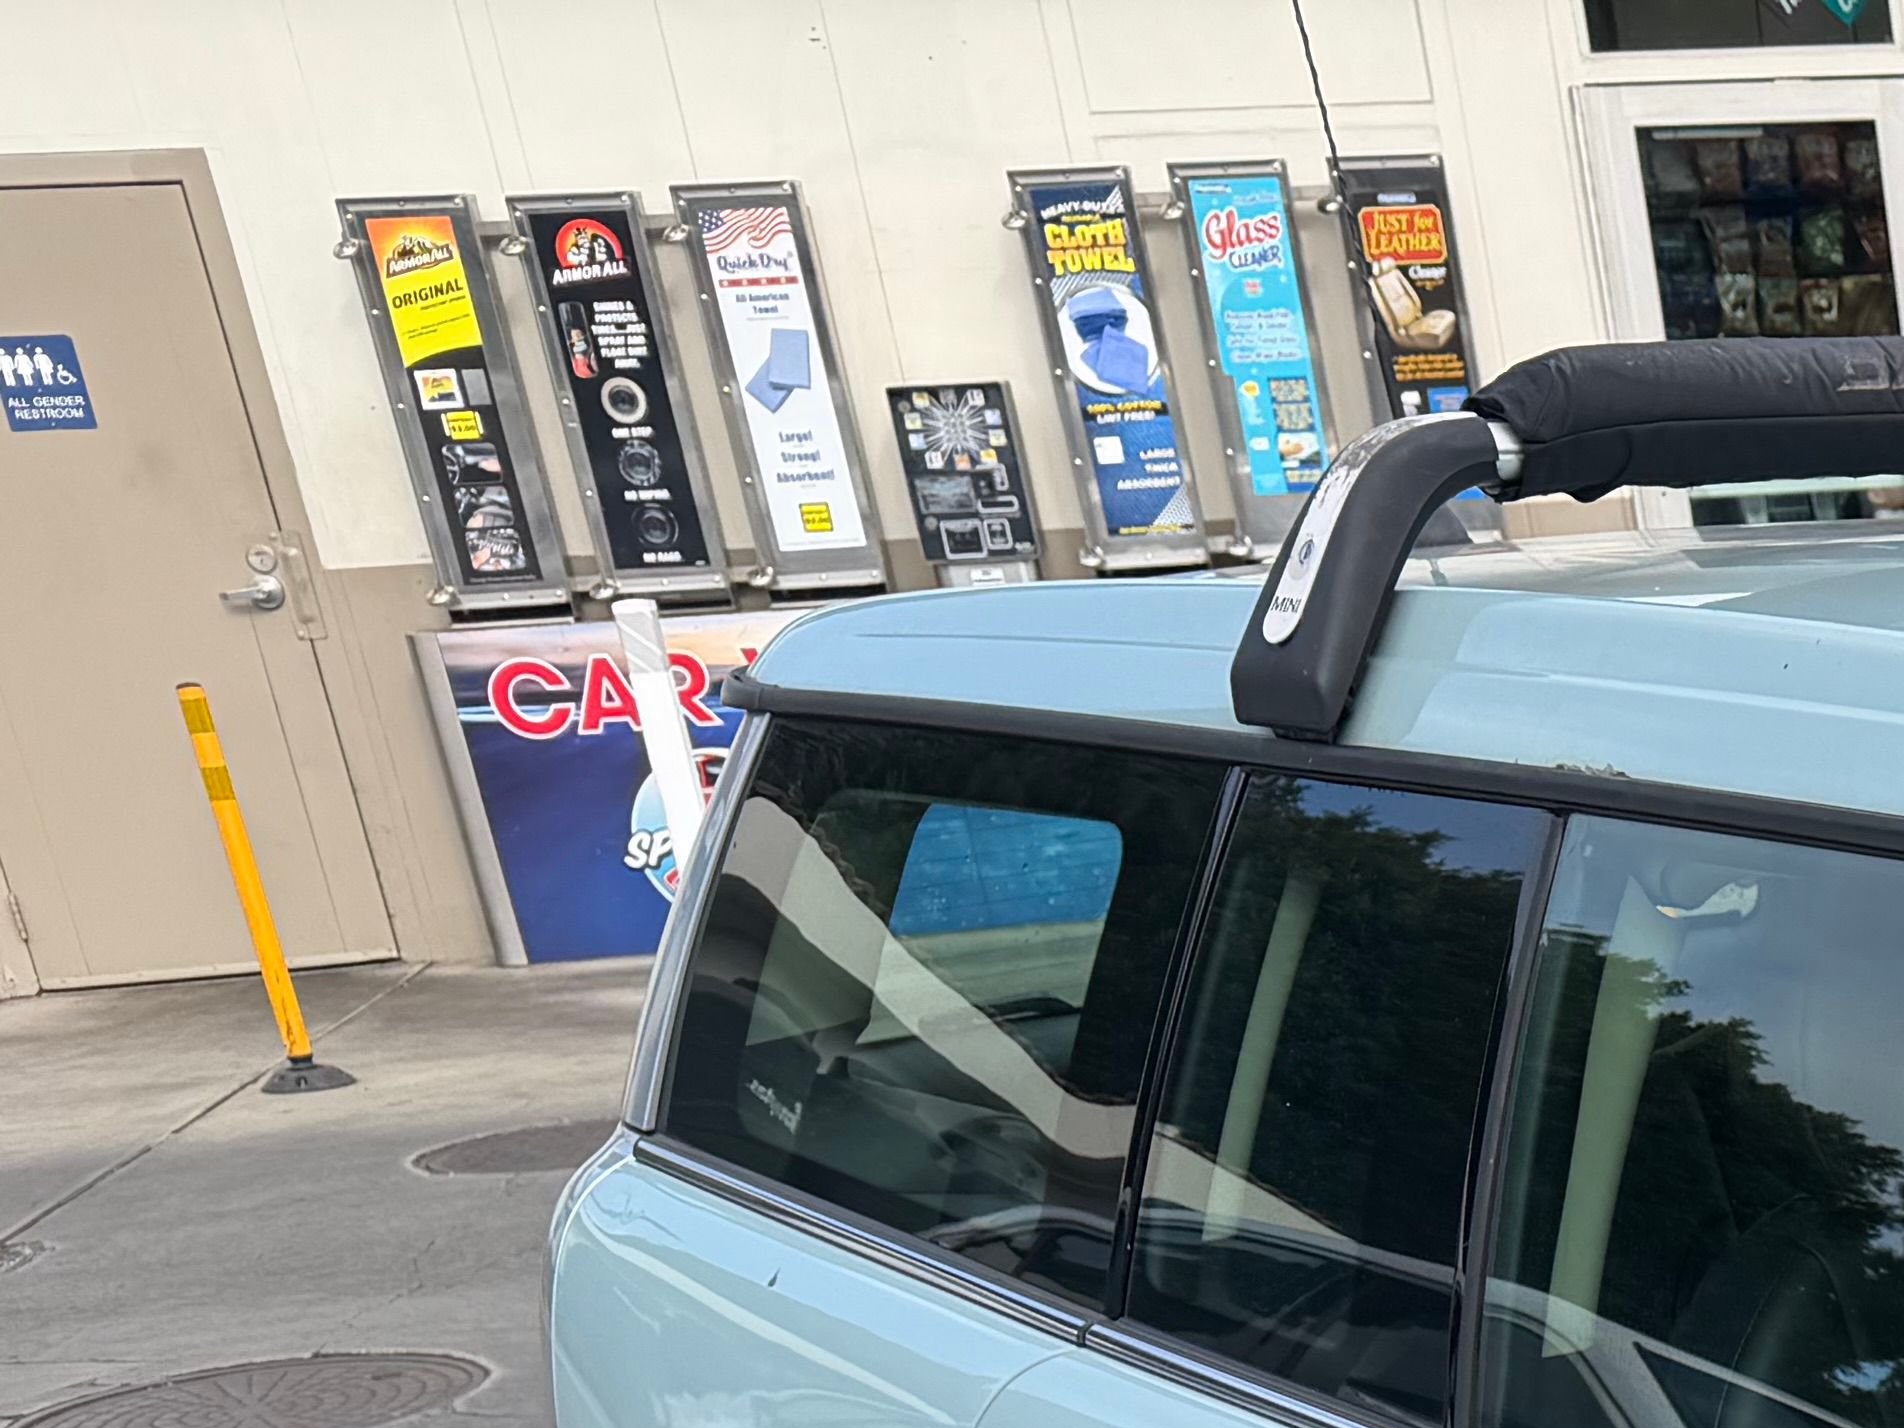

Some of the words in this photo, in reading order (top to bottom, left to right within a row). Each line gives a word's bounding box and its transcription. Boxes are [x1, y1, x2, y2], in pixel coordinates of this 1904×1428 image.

[1044, 219, 1126, 249] CLOTH
[1205, 210, 1280, 260] Glass
[1366, 211, 1408, 236] JUST
[1369, 231, 1441, 256] LEATHER
[1046, 246, 1136, 276] TOWEL
[392, 278, 464, 309] ORIGINAL
[8, 397, 30, 408] ALL
[32, 395, 86, 407] GENDER
[14, 407, 85, 420] RESTROOM
[1271, 595, 1302, 613] MINI
[488, 652, 725, 740] CAR
